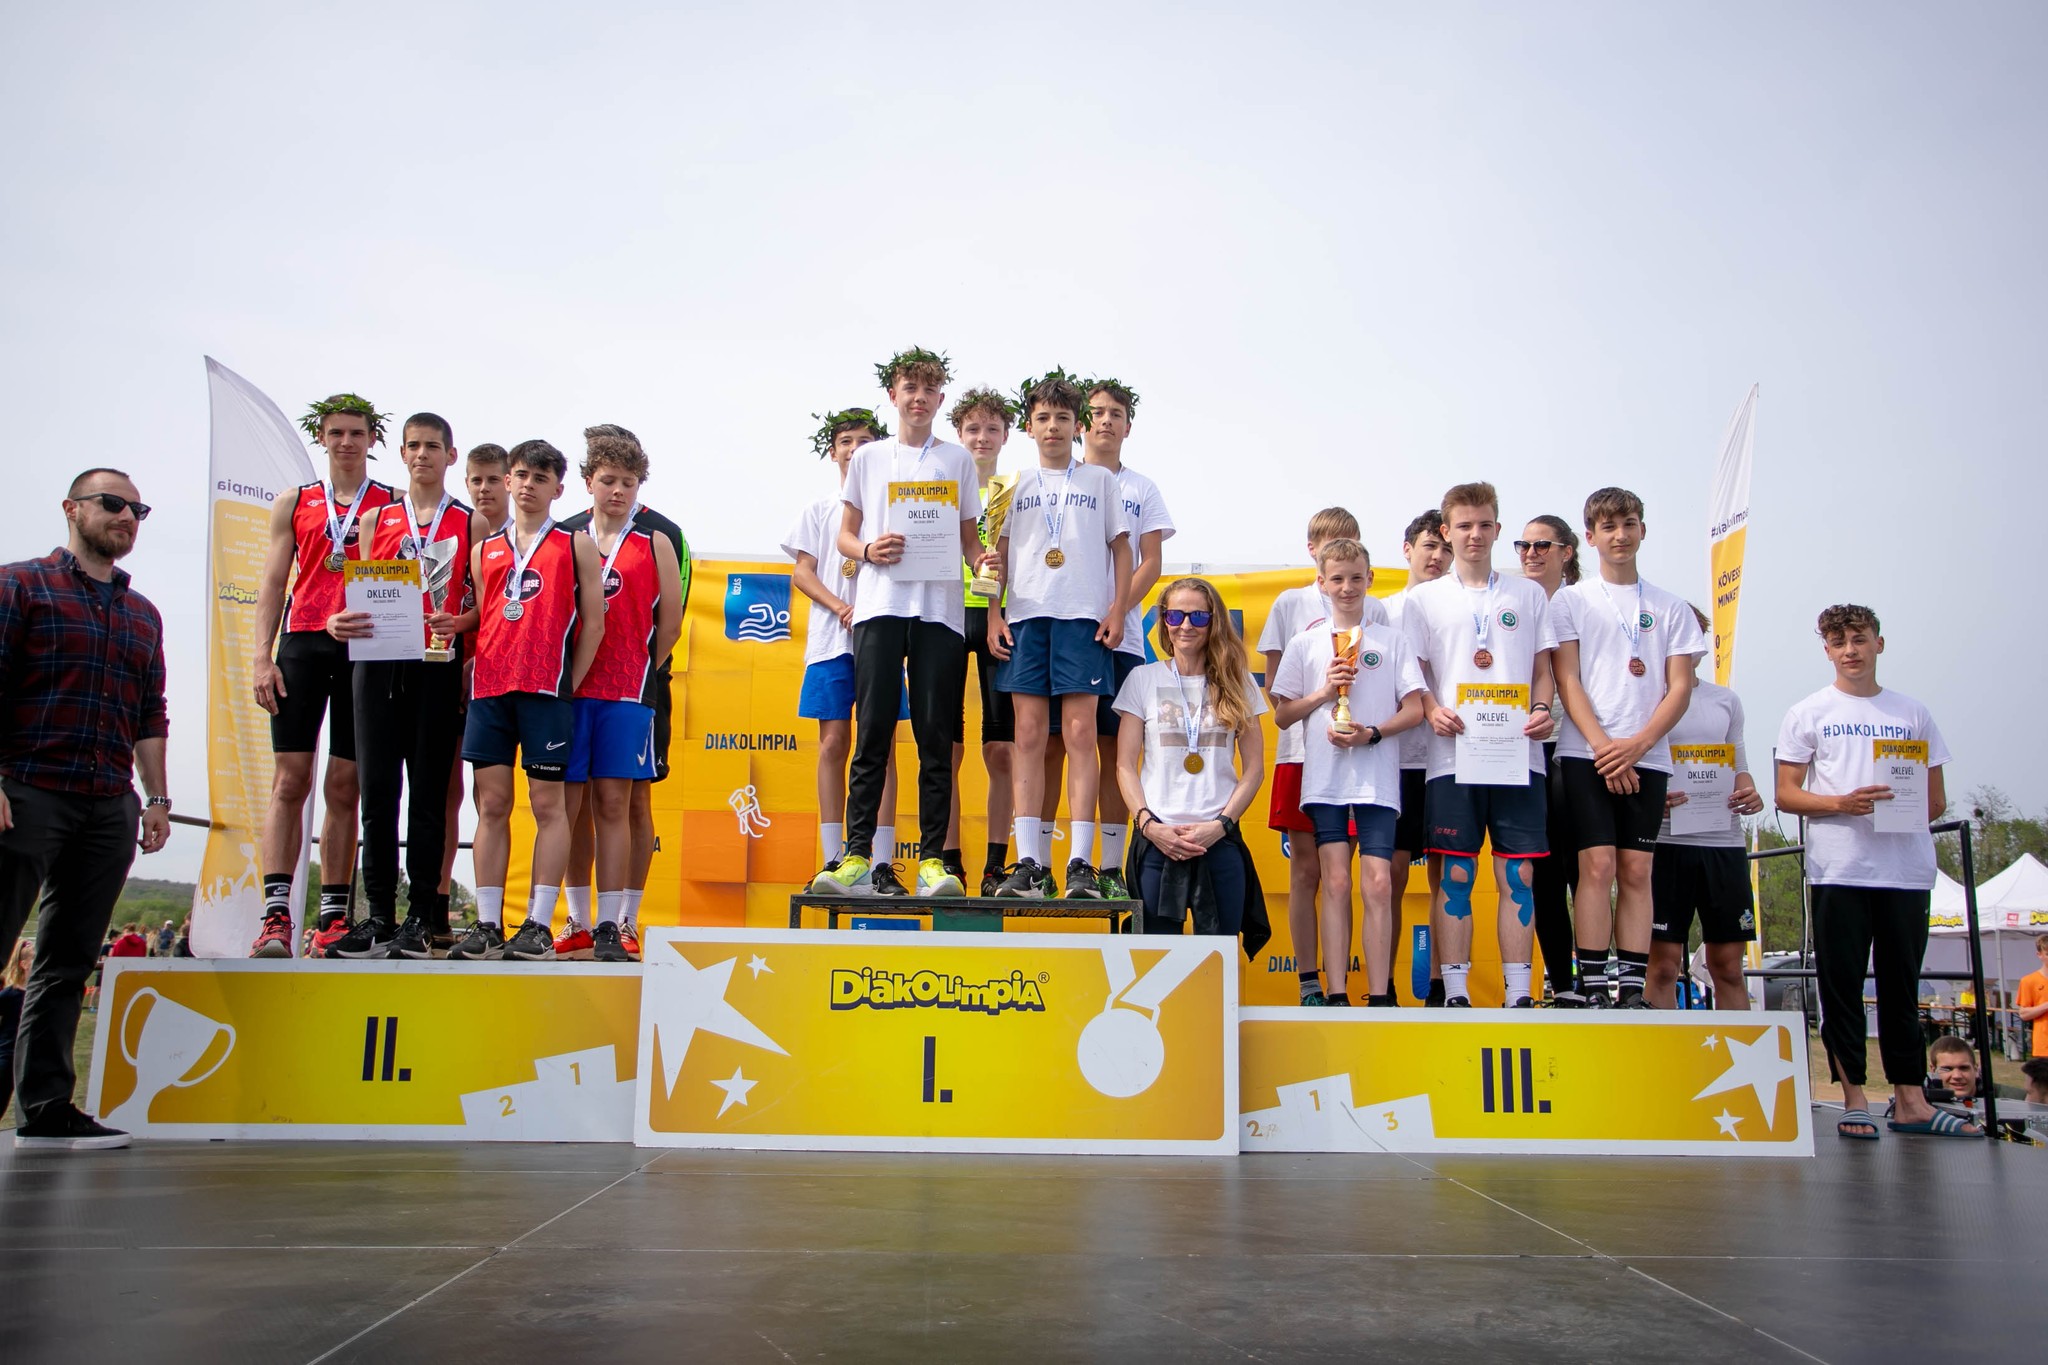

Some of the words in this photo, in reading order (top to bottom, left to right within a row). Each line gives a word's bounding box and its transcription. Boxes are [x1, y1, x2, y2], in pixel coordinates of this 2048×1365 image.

[1016, 493, 1097, 513] #DIAOIMPIA
[908, 508, 940, 520] OKLEVÉL
[367, 588, 402, 599] OKLEVÉL
[1476, 711, 1510, 722] OKLEVÉL
[705, 733, 798, 751] DIAKOLIMPIA
[1823, 724, 1912, 741] #DIAKOLIMPIA
[1687, 769, 1718, 780] OKLEVÉL
[1418, 930, 1427, 951] TORNA
[362, 1016, 411, 1081] II.
[569, 1062, 581, 1086] 1
[922, 1036, 953, 1103] I.
[1481, 1047, 1552, 1113] III.
[499, 1095, 516, 1117] 2
[1309, 1089, 1321, 1111] 1
[1246, 1120, 1263, 1137] 2
[1382, 1111, 1399, 1131] 3
